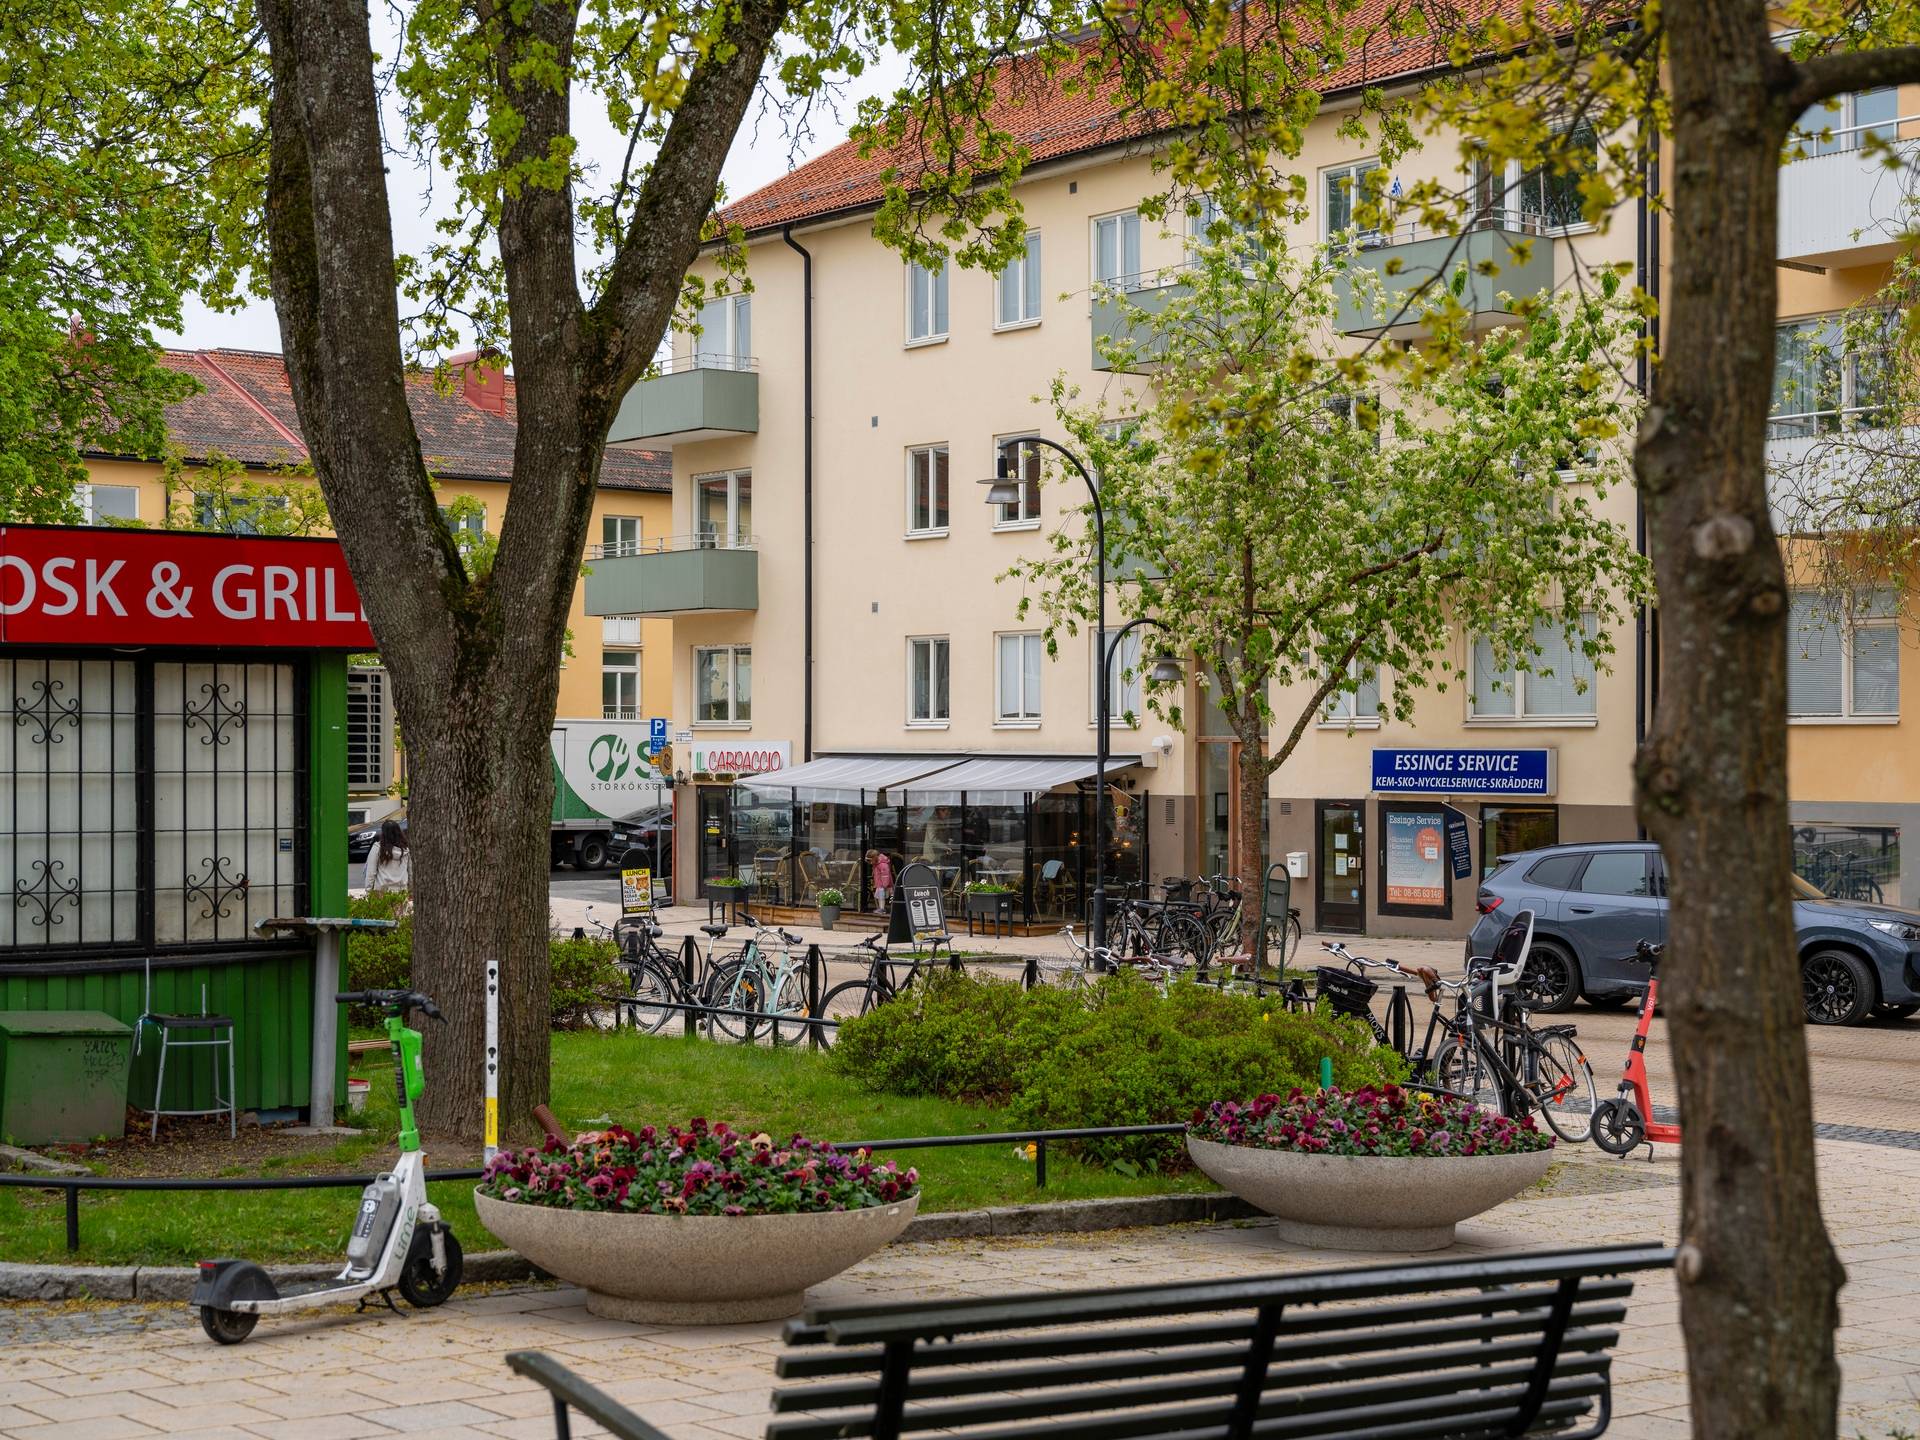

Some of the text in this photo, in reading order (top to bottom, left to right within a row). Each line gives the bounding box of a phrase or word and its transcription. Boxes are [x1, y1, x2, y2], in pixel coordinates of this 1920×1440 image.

[145, 560, 194, 619] &
[211, 564, 370, 622] GRIL
[654, 719, 664, 735] P
[696, 750, 781, 772] IL CARPACCIO
[1394, 754, 1519, 772] ESSINGE SERVICE
[1375, 776, 1544, 789] KEM-SKO-NYCKELSERVICE-SKRÄDDERI
[1389, 815, 1415, 826] Essinge
[1416, 816, 1441, 825] Service
[1389, 887, 1402, 897] Tel:
